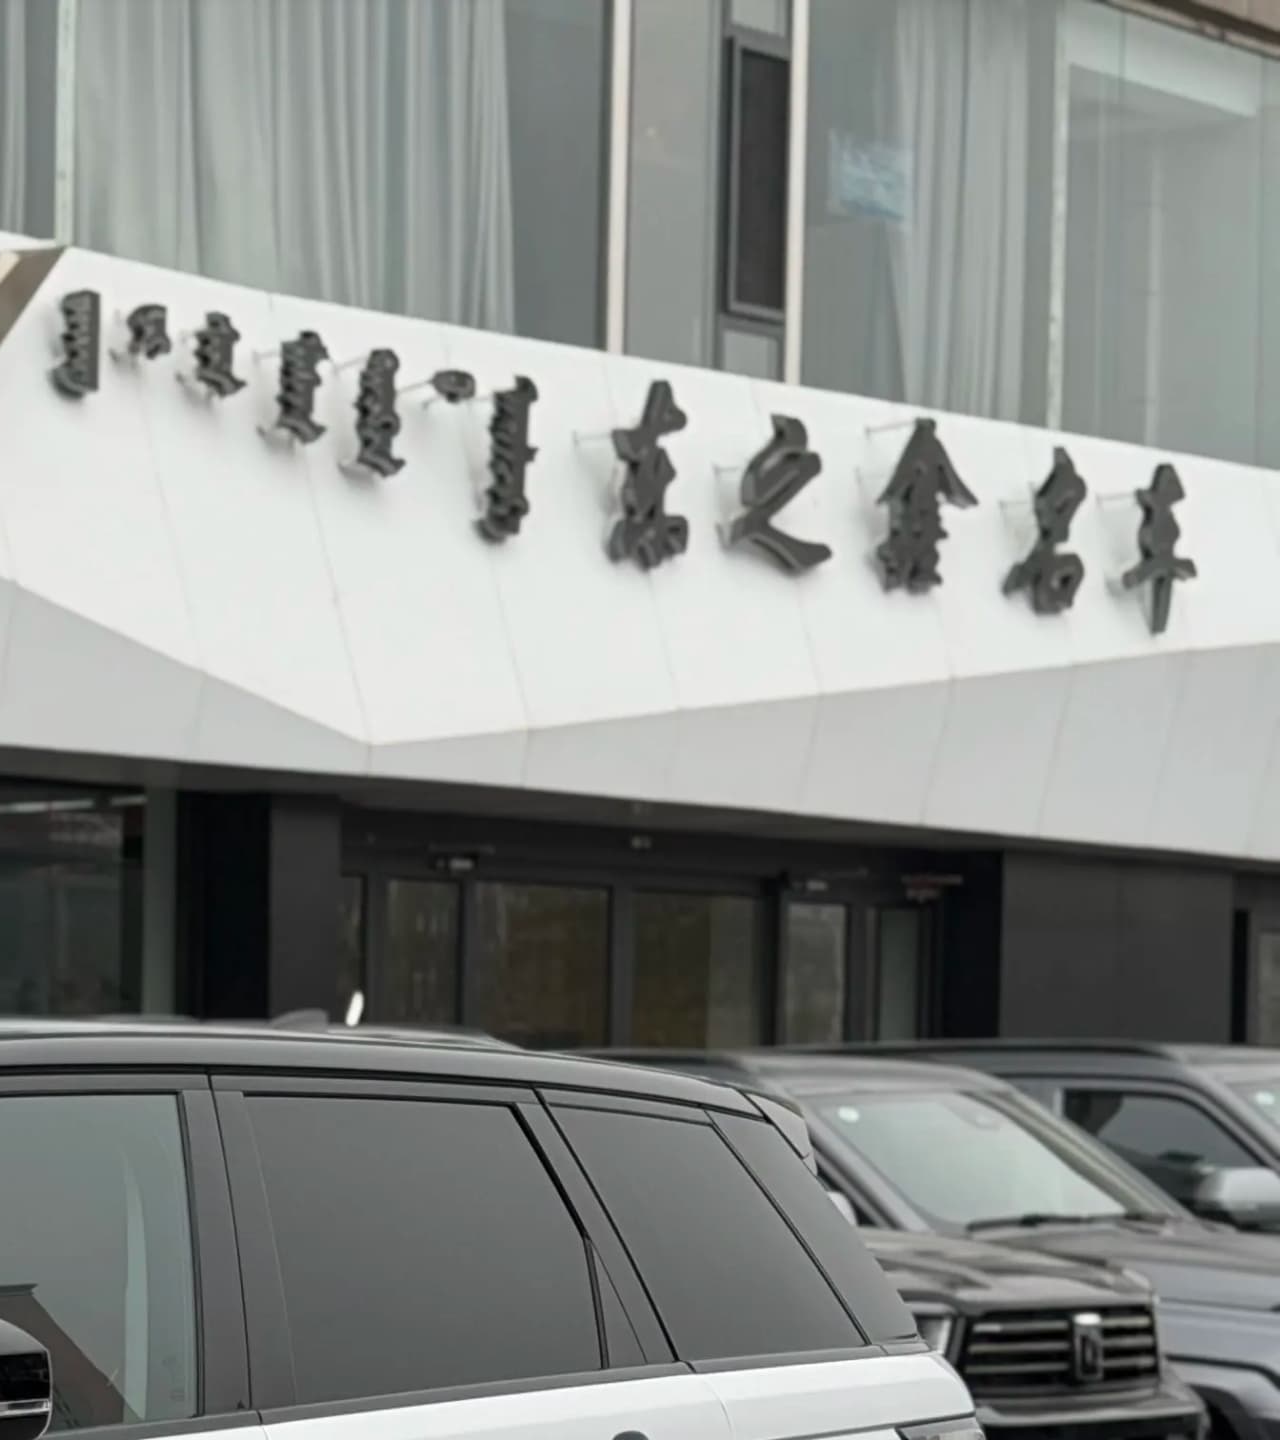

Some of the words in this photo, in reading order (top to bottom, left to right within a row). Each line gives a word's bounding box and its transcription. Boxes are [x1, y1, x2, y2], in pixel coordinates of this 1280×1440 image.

[604, 379, 1198, 636] 东之鑫名车
